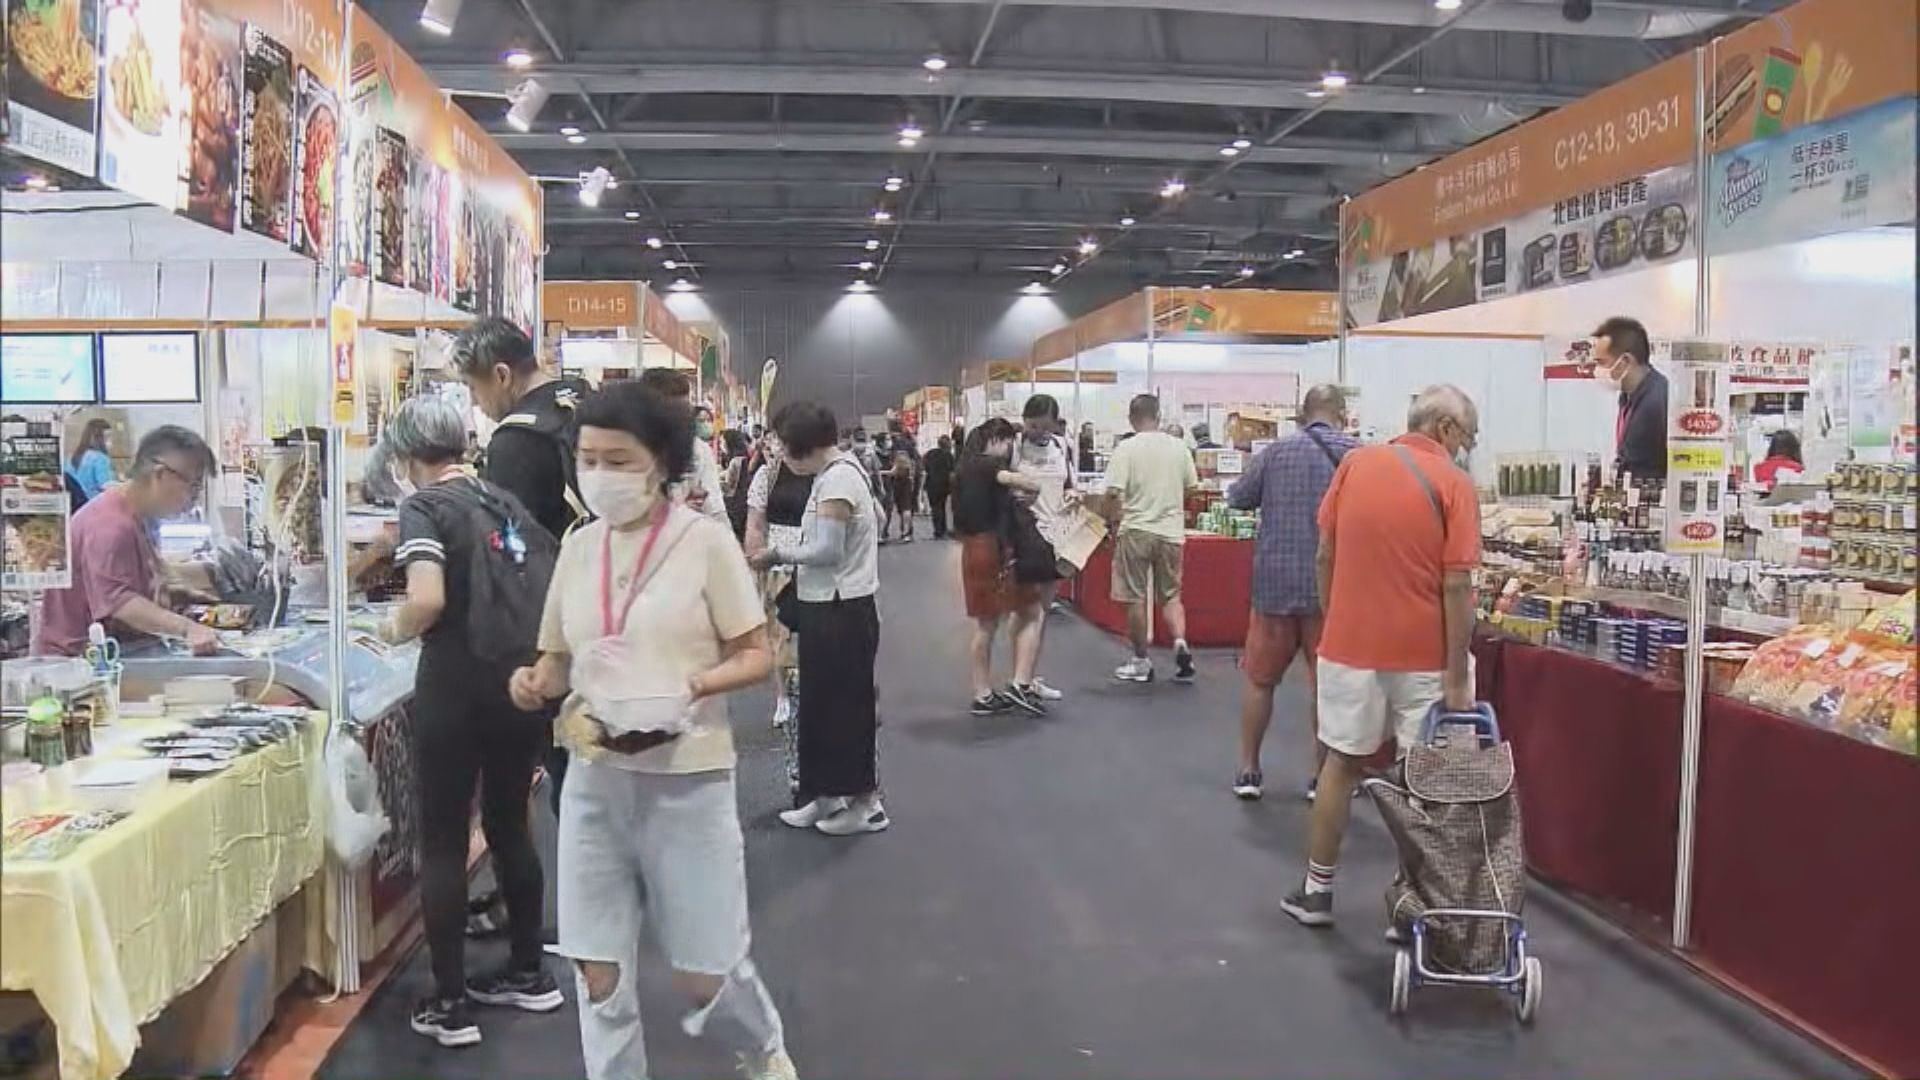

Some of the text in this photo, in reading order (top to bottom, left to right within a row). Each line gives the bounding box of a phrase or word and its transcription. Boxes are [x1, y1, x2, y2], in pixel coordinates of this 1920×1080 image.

[1555, 96, 1679, 170] C12-13, 30-31
[568, 297, 627, 314] D14-15
